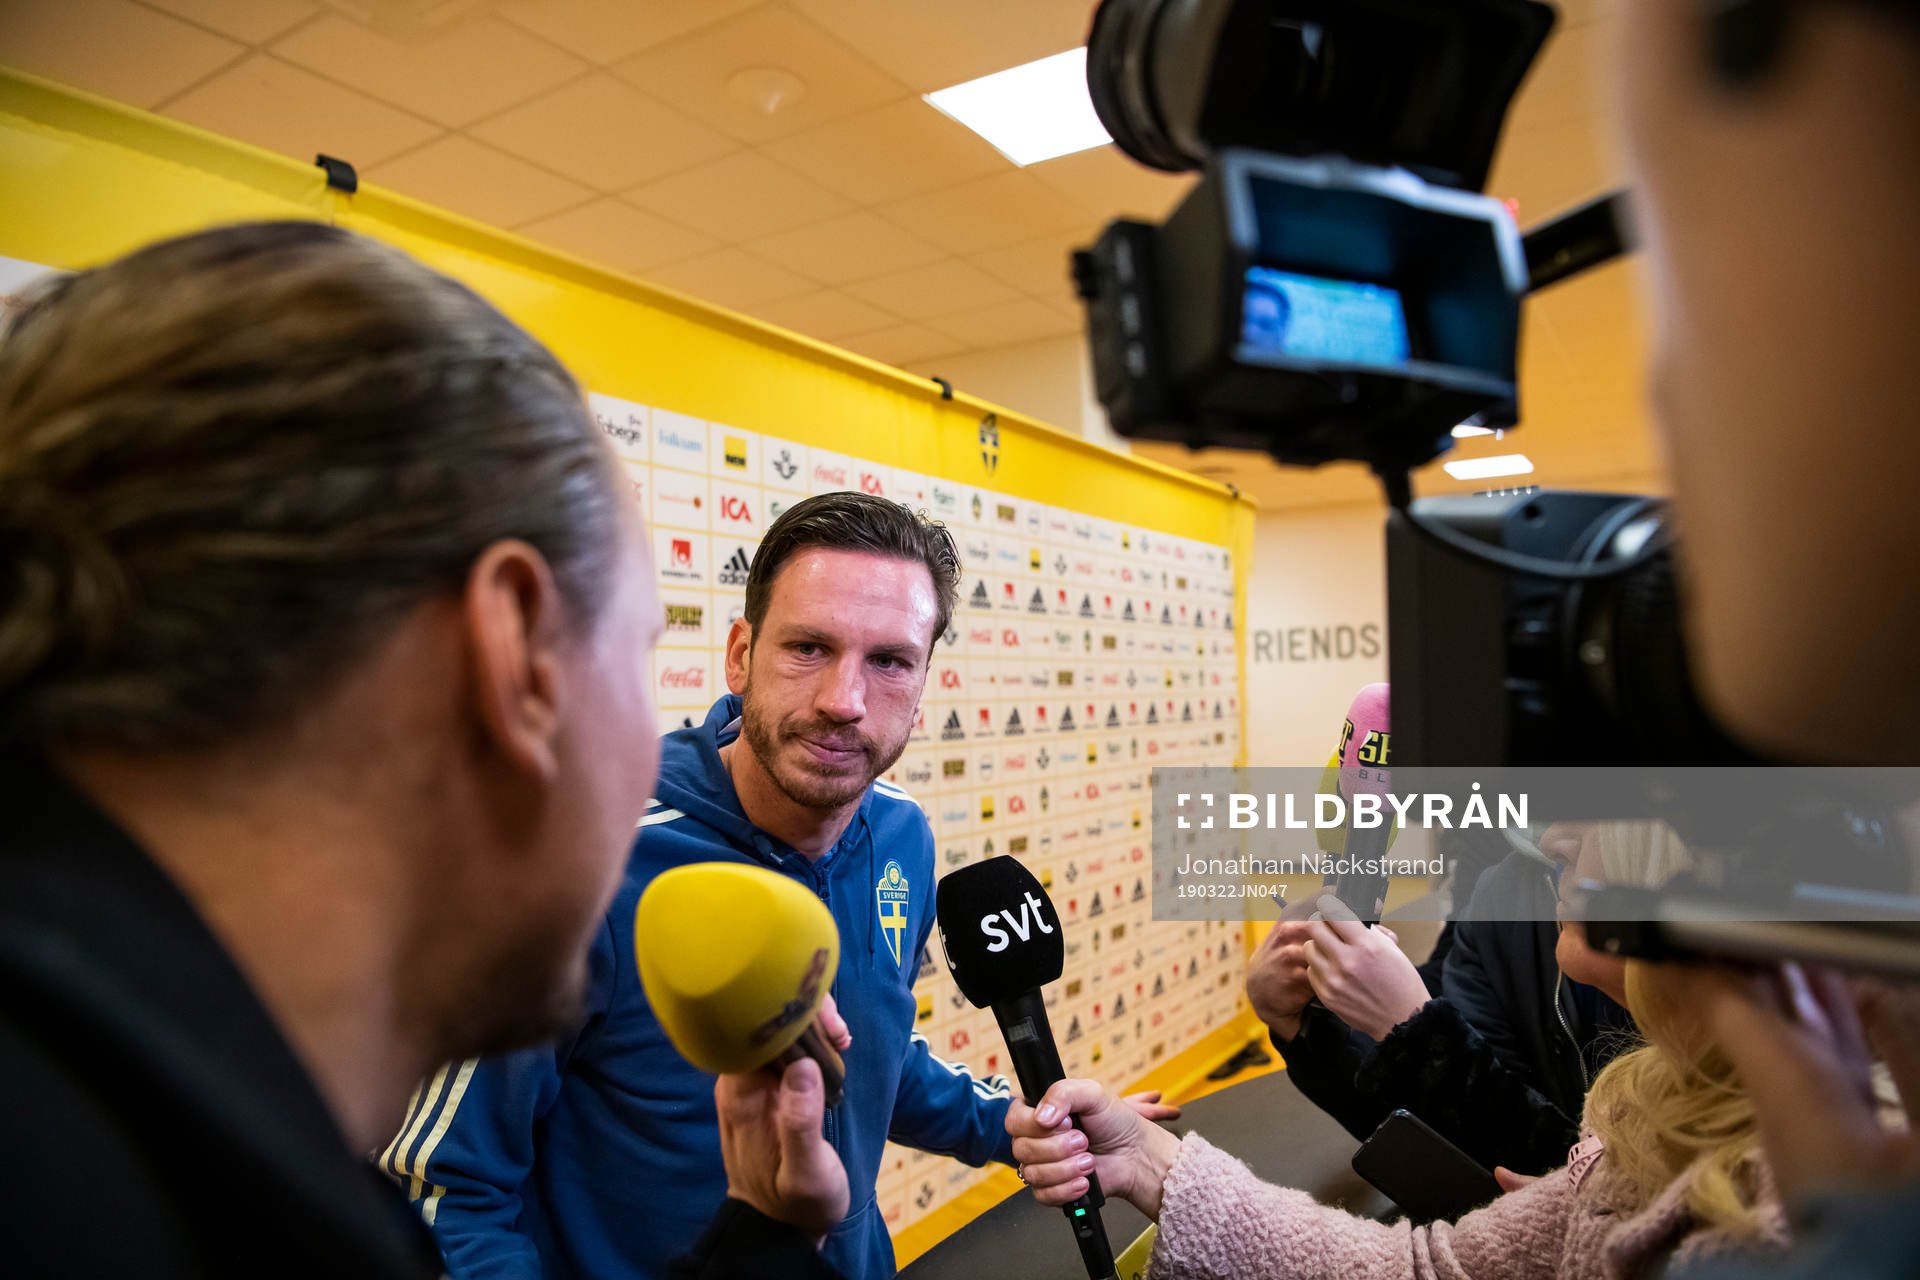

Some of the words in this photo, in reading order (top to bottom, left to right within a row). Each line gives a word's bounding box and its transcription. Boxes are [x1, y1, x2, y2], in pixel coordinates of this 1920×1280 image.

[720, 496, 752, 523] ICA
[882, 891, 907, 900] SVERIGE
[981, 891, 1054, 953] svt
